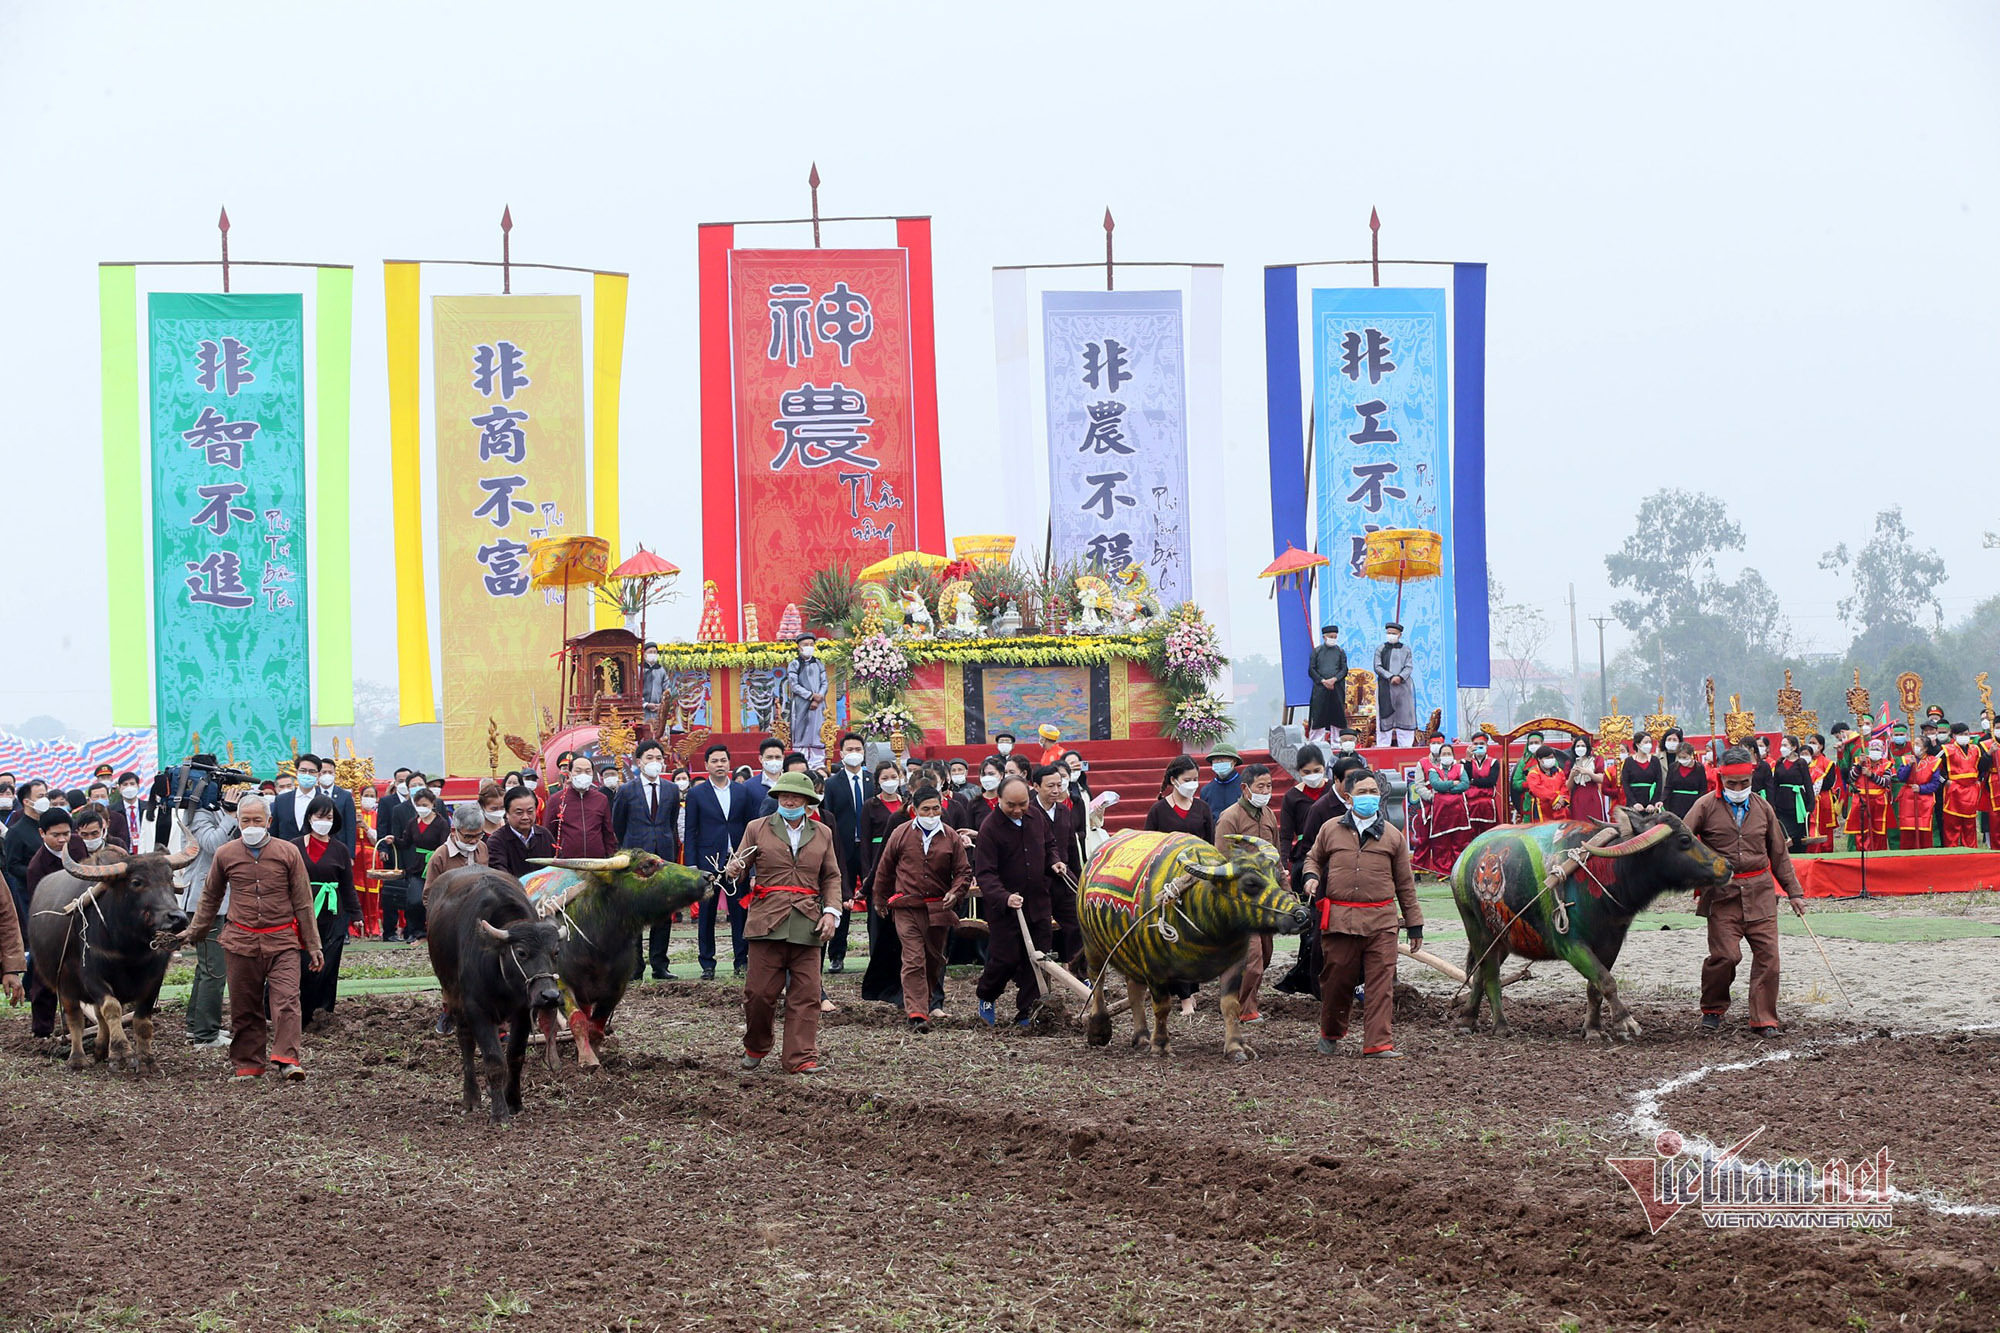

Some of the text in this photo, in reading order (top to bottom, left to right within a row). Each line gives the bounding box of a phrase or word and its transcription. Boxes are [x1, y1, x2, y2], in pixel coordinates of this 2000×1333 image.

[768, 282, 880, 470] 神農
[471, 341, 535, 598] 非商不富
[1340, 328, 1407, 578] 非工不
[182, 336, 260, 610] 非智不進
[1416, 463, 1434, 487] Phi
[540, 501, 564, 527] Phi
[838, 471, 903, 518] Thần
[1151, 486, 1177, 511] Phi
[264, 509, 290, 531] Phi
[851, 517, 895, 556] nông
[1104, 846, 1148, 870] 2022
